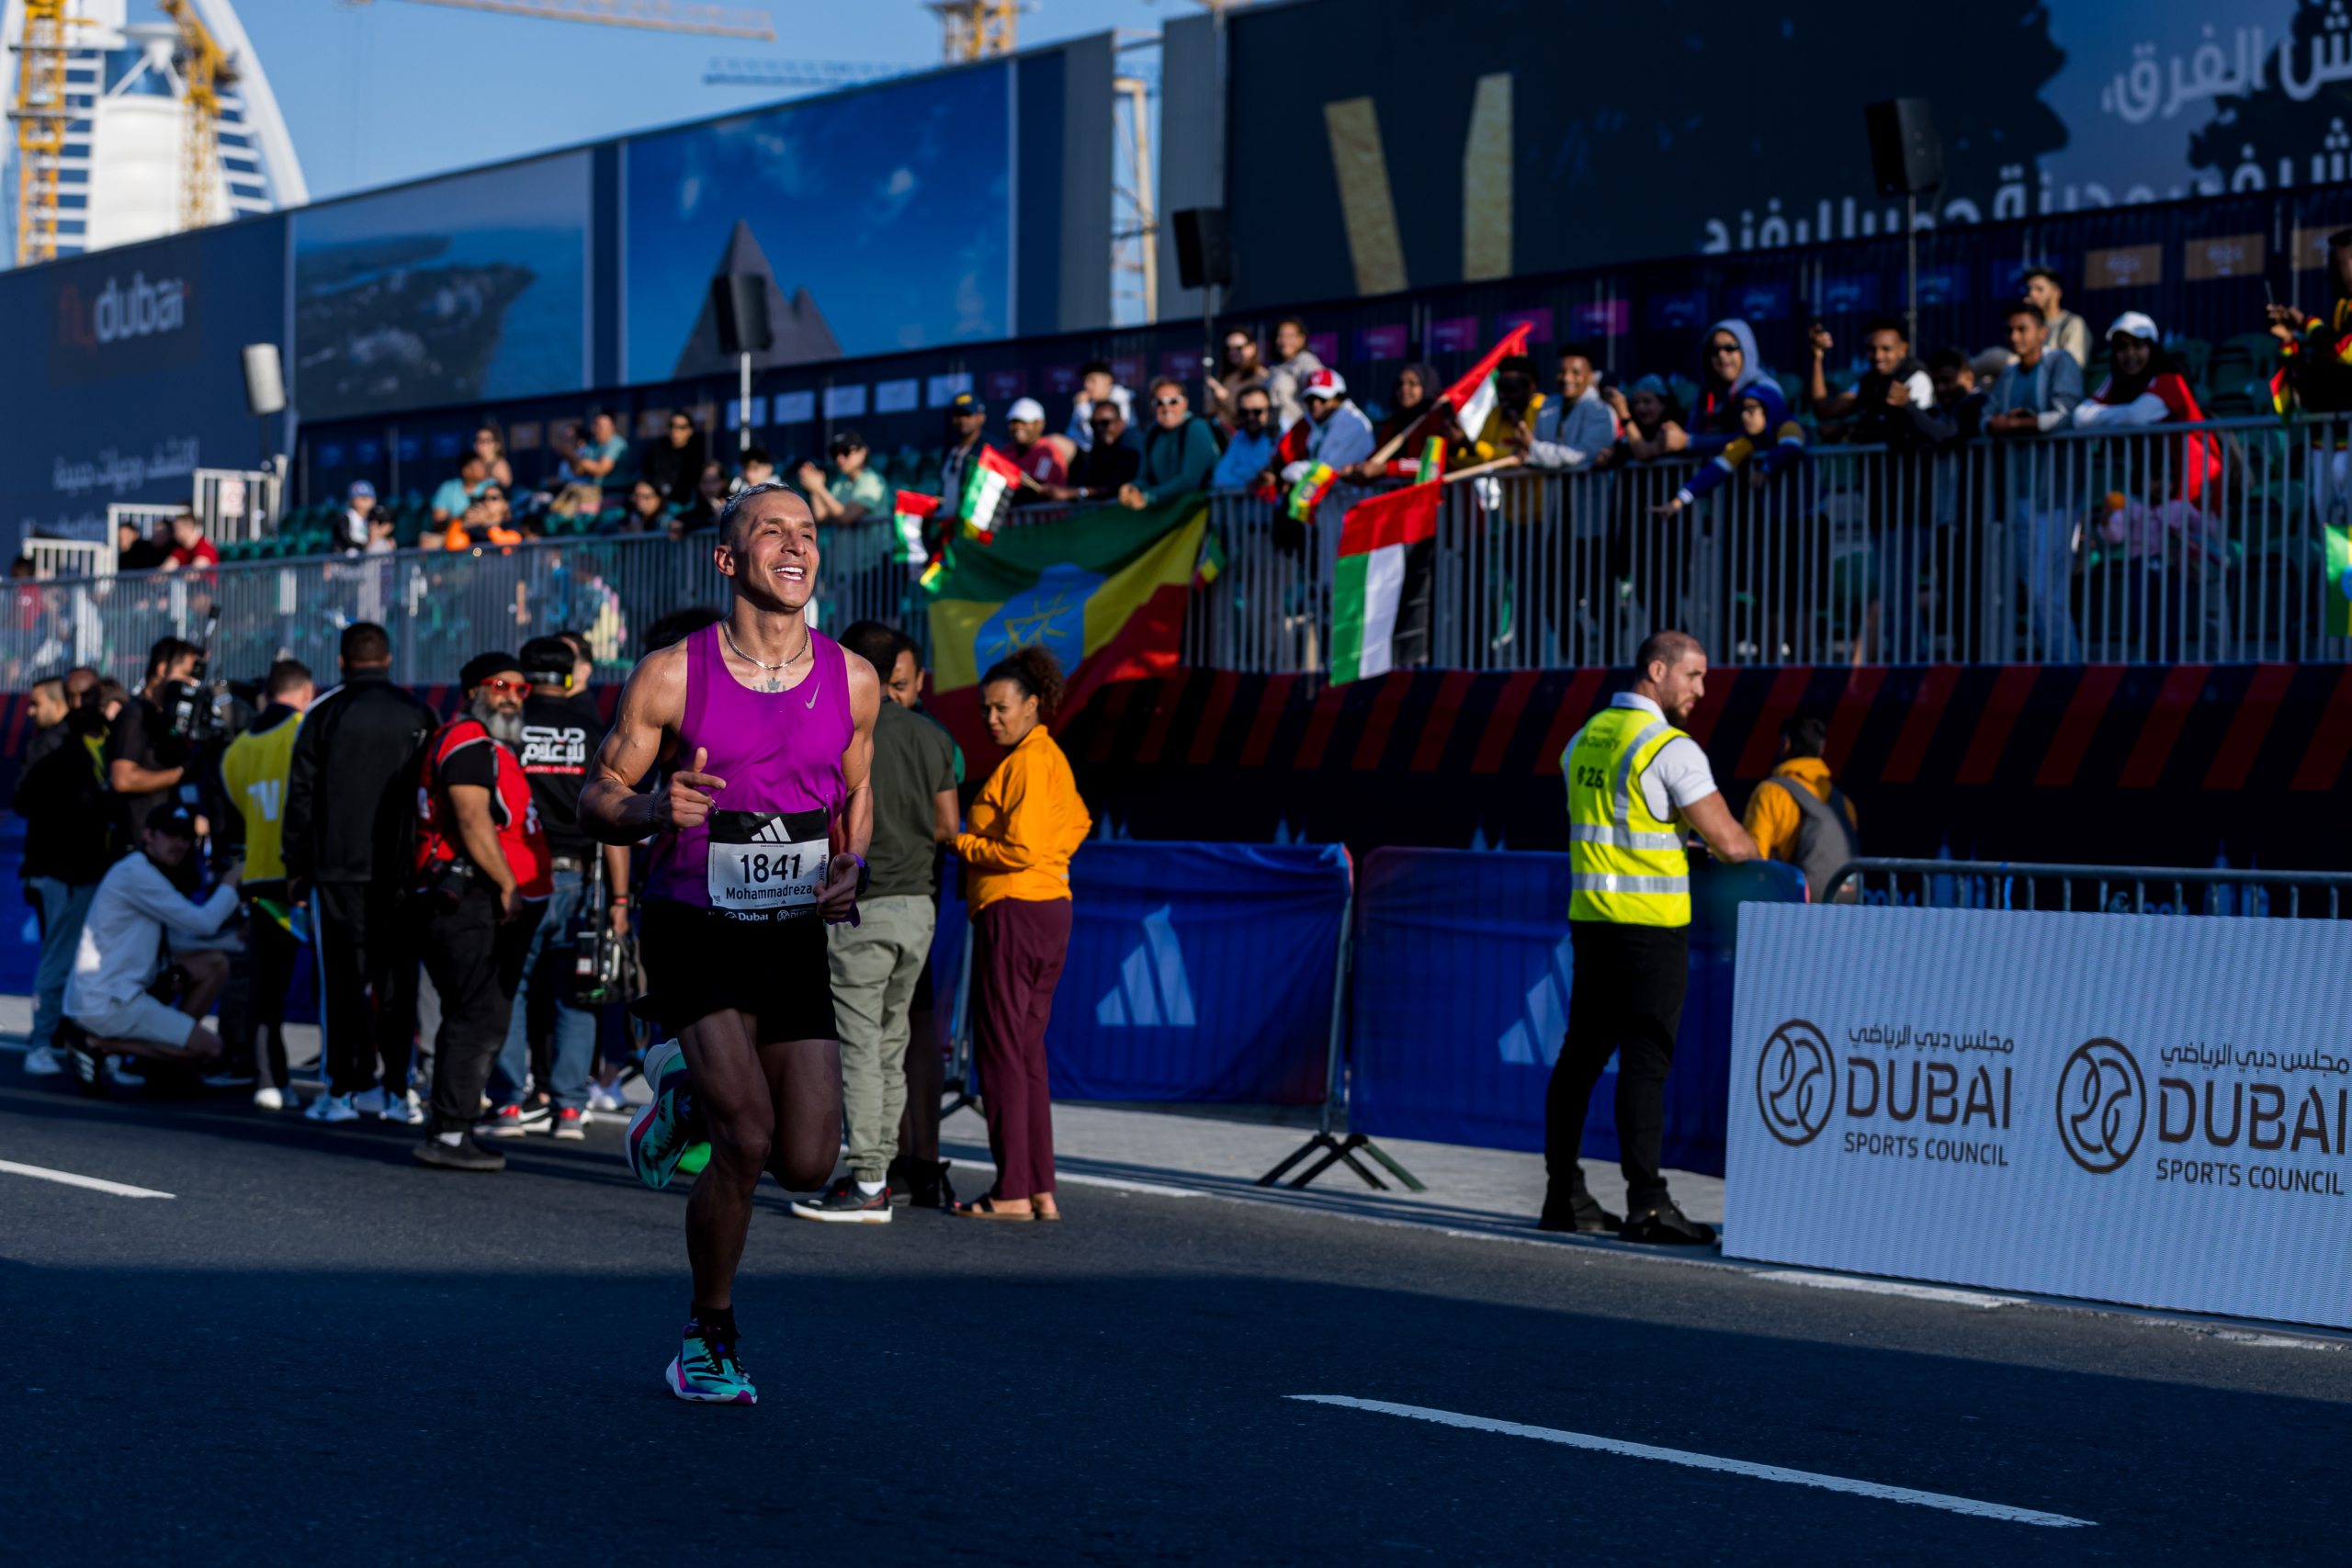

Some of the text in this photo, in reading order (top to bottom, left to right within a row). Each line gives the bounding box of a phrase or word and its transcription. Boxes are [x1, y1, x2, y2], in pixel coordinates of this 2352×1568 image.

[740, 853, 801, 884] 1841
[819, 853, 827, 882] MARATHO
[726, 884, 812, 900] Mohammadreza
[1849, 1023, 2013, 1057] مجلس دبي الرياضي
[2161, 1042, 2350, 1077] مجلس دبي الرياضي
[1846, 1055, 2012, 1129] DUBAI
[2158, 1077, 2347, 1156] DUBAI
[1844, 1132, 2009, 1167] SPORTS COUNCIL
[2156, 1157, 2345, 1196] SPORTS COUNCIL
